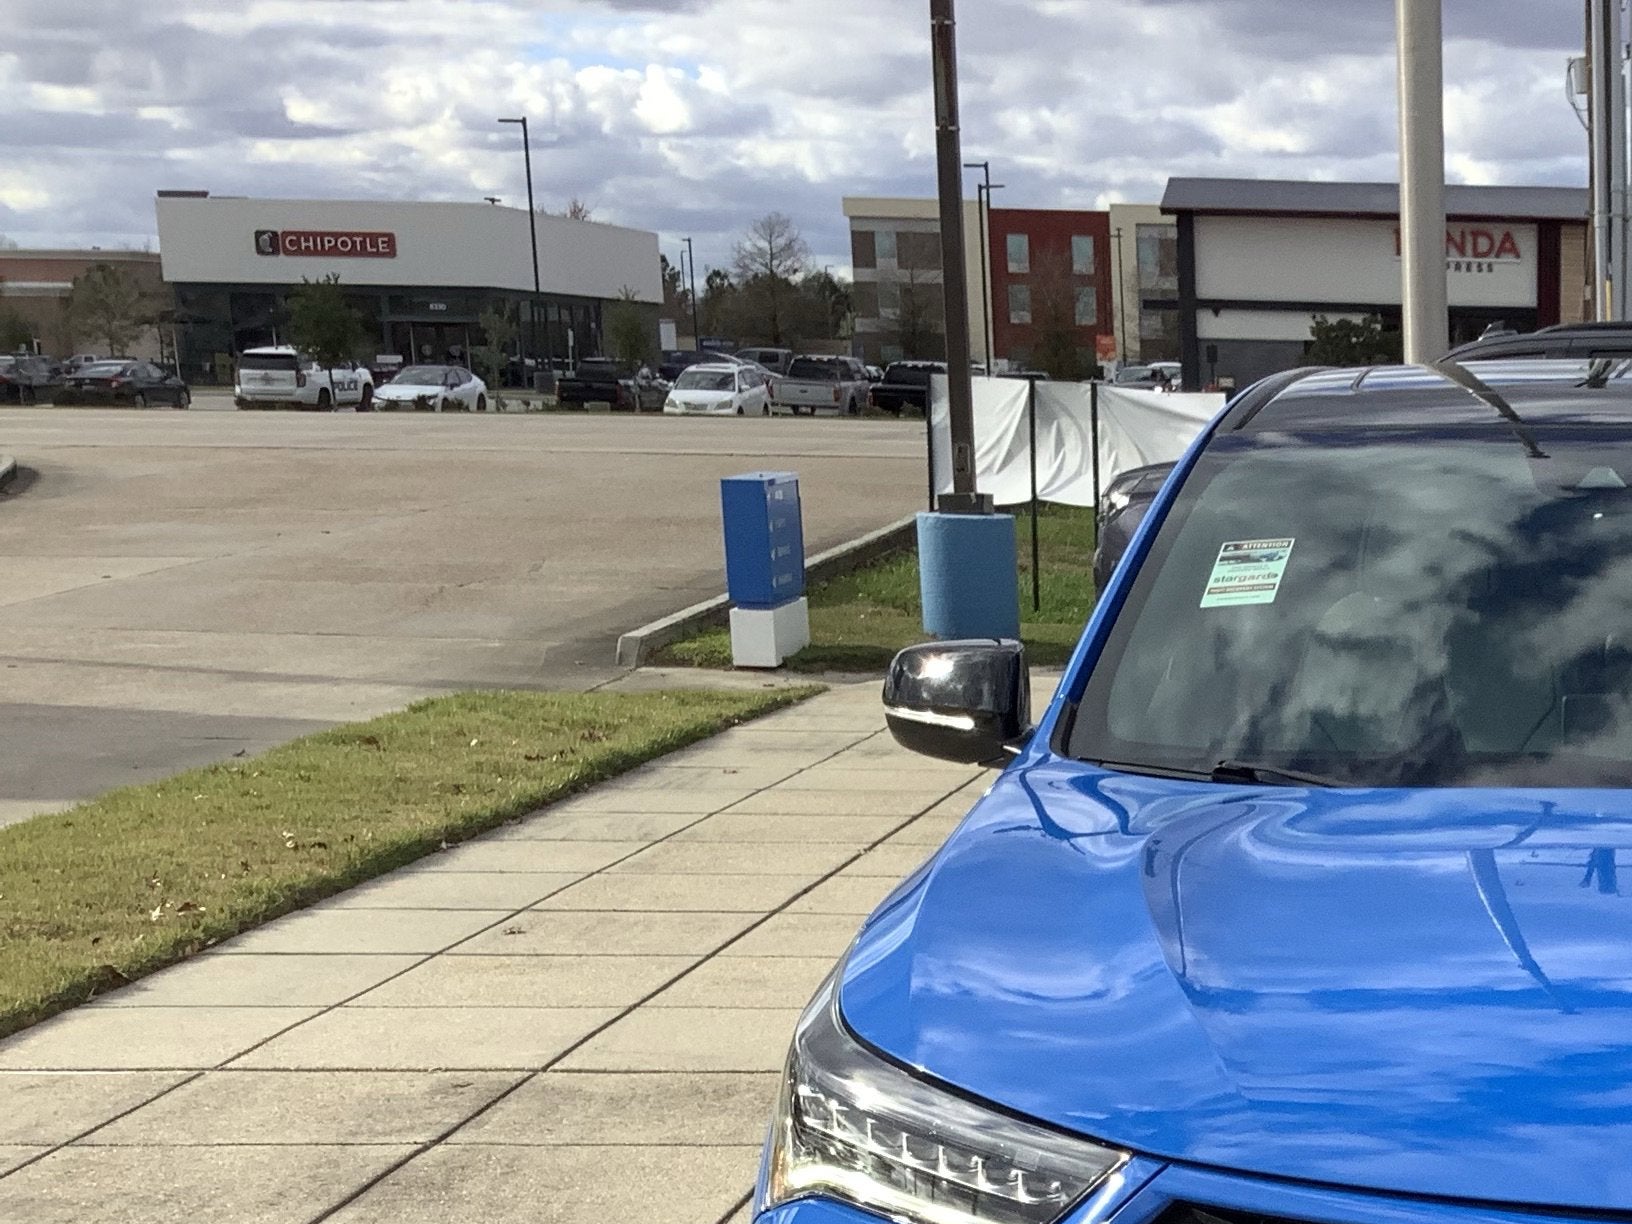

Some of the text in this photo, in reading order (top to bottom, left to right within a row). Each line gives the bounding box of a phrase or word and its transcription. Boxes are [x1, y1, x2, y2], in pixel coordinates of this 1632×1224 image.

[285, 236, 390, 252] CHIPOTLE
[1393, 227, 1520, 258] NDA
[1242, 541, 1289, 550] ATTENTION
